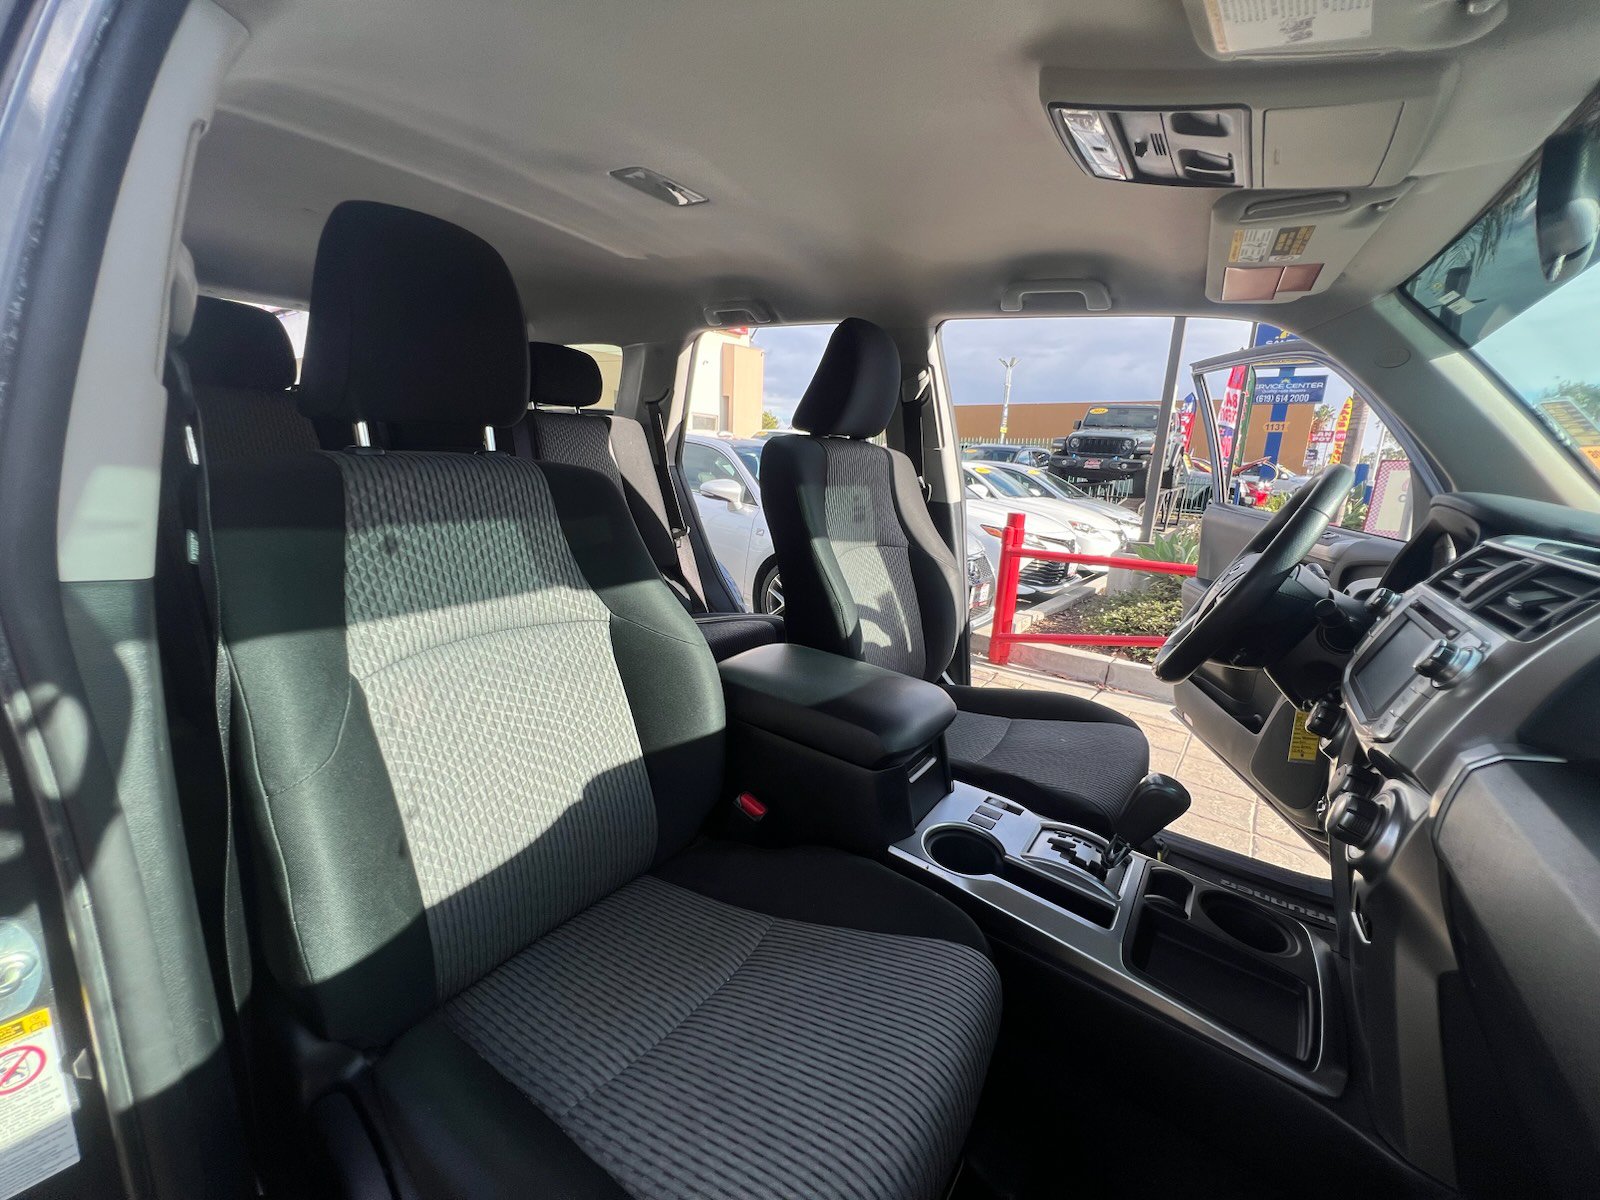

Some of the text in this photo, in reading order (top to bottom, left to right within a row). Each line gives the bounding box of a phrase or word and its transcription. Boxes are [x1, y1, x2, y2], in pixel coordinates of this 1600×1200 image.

[1255, 394, 1310, 403] (619) 614 2000
[1265, 423, 1285, 431] 1131
